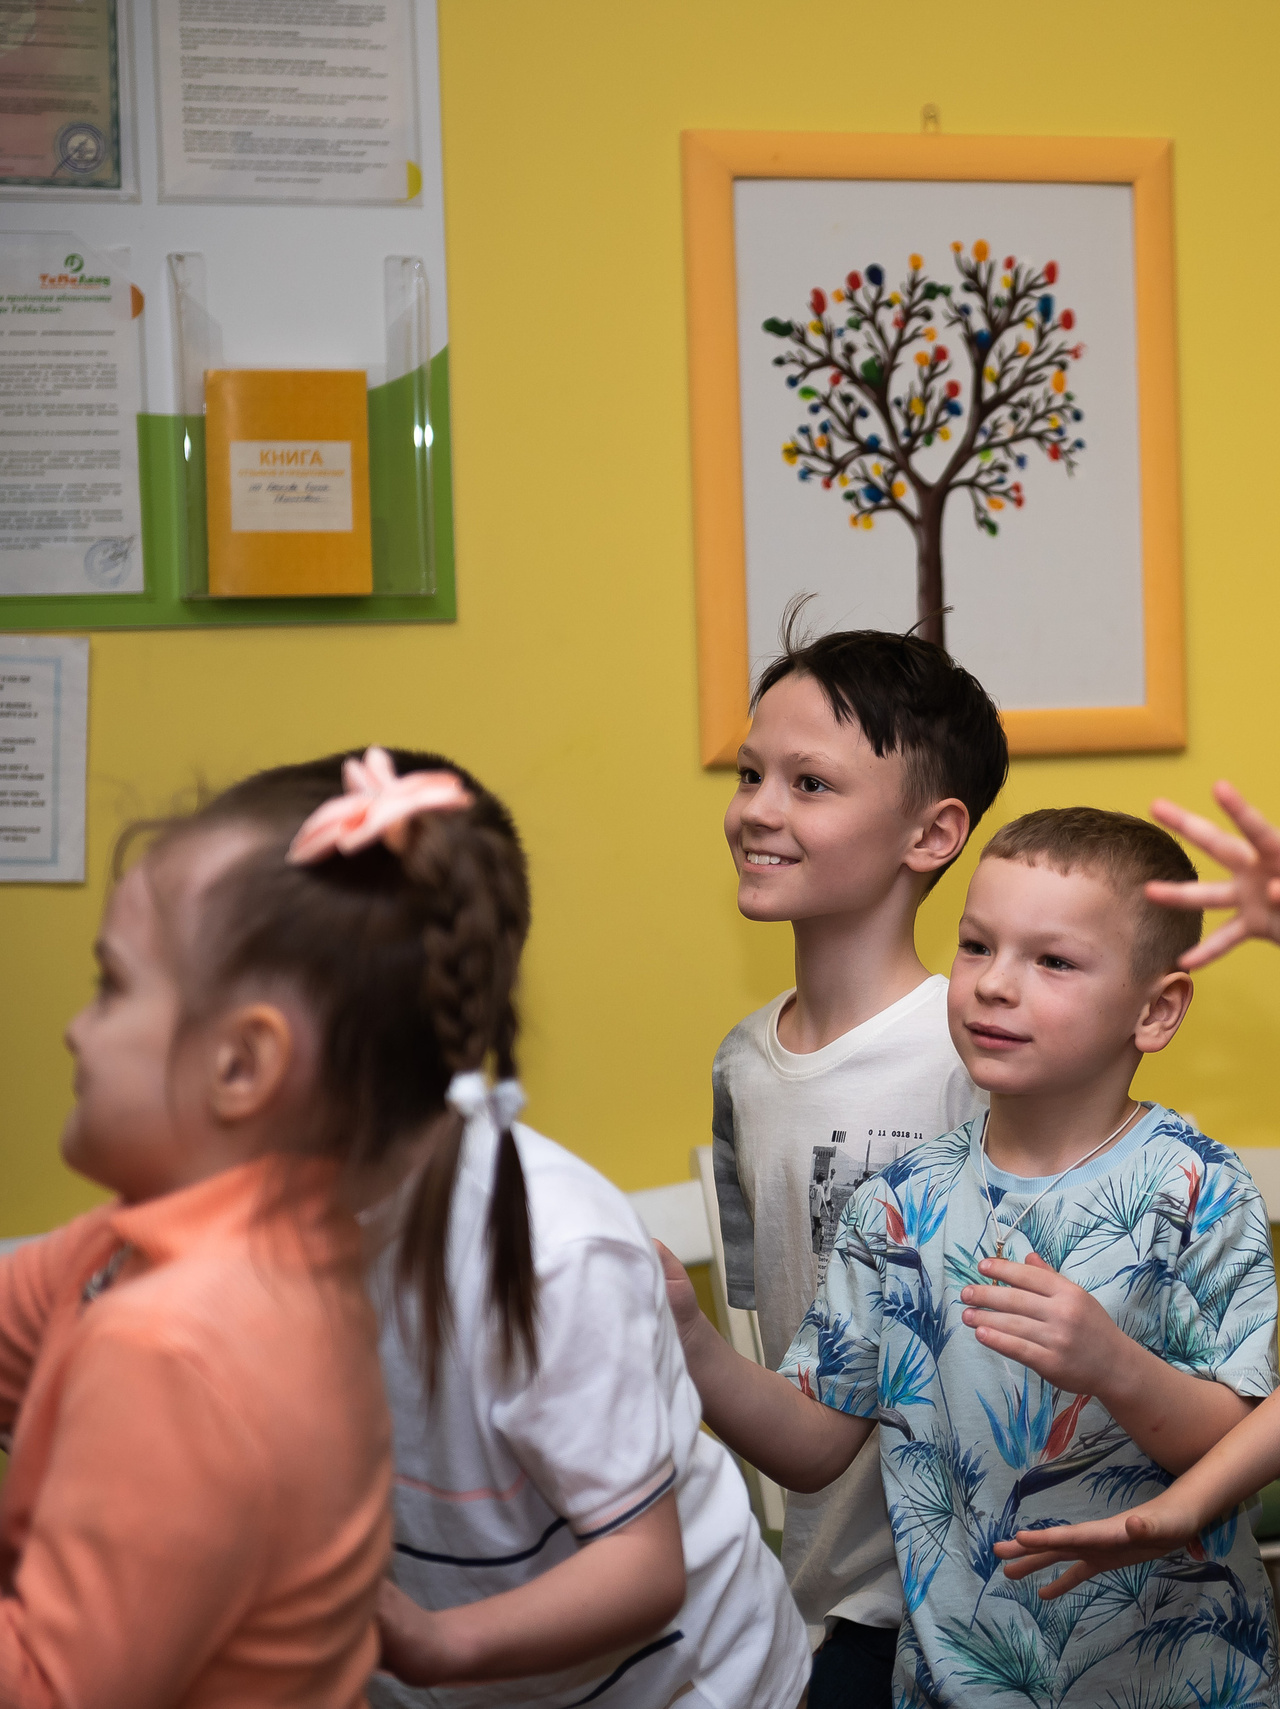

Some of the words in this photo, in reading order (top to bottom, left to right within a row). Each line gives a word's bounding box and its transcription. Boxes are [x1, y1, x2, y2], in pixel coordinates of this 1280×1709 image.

[259, 448, 324, 467] КНИГА
[877, 1129, 886, 1137] 11
[891, 1130, 910, 1139] 0318
[913, 1132, 923, 1140] 11
